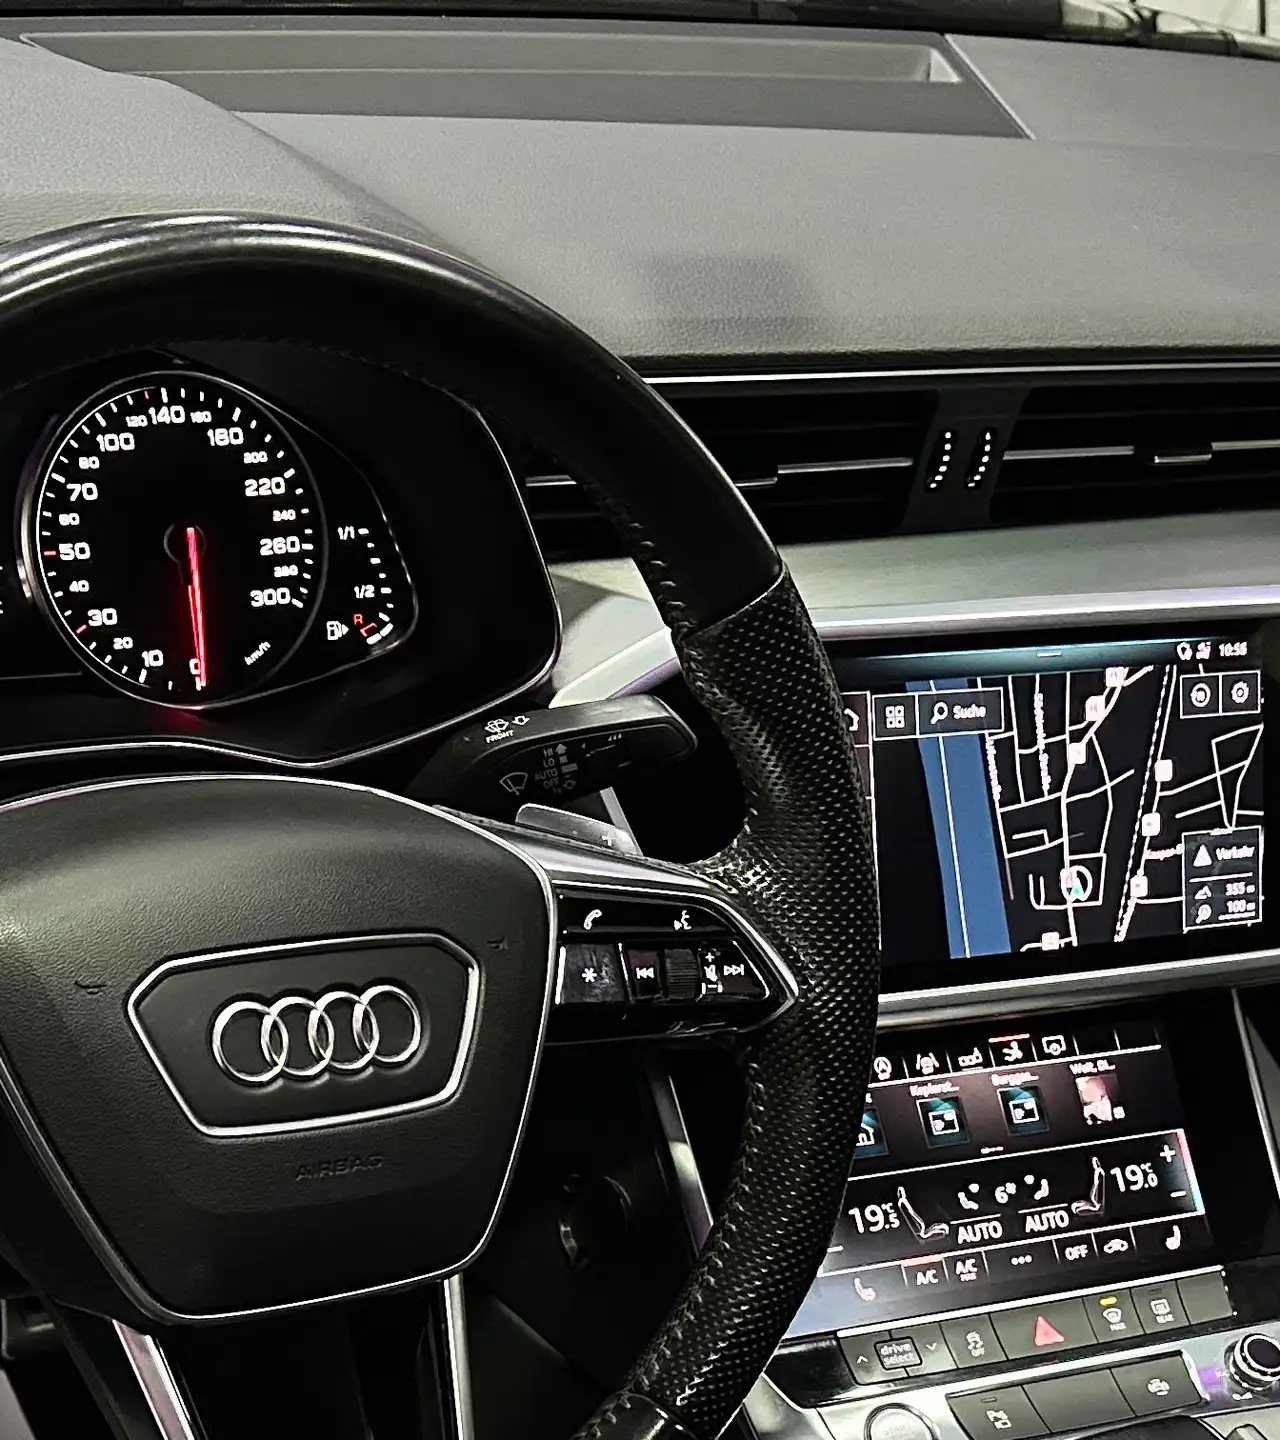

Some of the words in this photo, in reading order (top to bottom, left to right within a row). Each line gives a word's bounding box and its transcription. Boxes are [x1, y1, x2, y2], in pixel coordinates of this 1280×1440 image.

[125, 415, 148, 428] 120
[148, 405, 186, 425] 140
[96, 432, 136, 452] 100
[207, 427, 244, 447] 180
[243, 451, 268, 464] 200
[66, 482, 99, 502] 70
[244, 476, 286, 497] 220
[59, 513, 80, 526] 60
[273, 509, 296, 522] 240
[337, 525, 355, 540] 1/1
[59, 543, 91, 561] 50
[259, 536, 301, 556] 260
[69, 580, 90, 593] 40
[353, 584, 375, 599] 1/2
[250, 588, 291, 608] 300
[88, 608, 118, 626] 30
[113, 636, 134, 649] 20
[142, 650, 164, 668] 10
[244, 640, 272, 665] km/h
[953, 703, 987, 719] Suche
[486, 730, 514, 743] FRONT
[294, 1155, 384, 1182] AIRBAG
[1025, 1209, 1070, 1233] AUTO
[957, 1220, 1003, 1245] AUTO
[1065, 1244, 1089, 1261] OFF
[955, 1257, 978, 1274] A/C
[915, 1268, 939, 1286] A/C
[879, 1341, 913, 1356] drive
[882, 1352, 917, 1367] select
